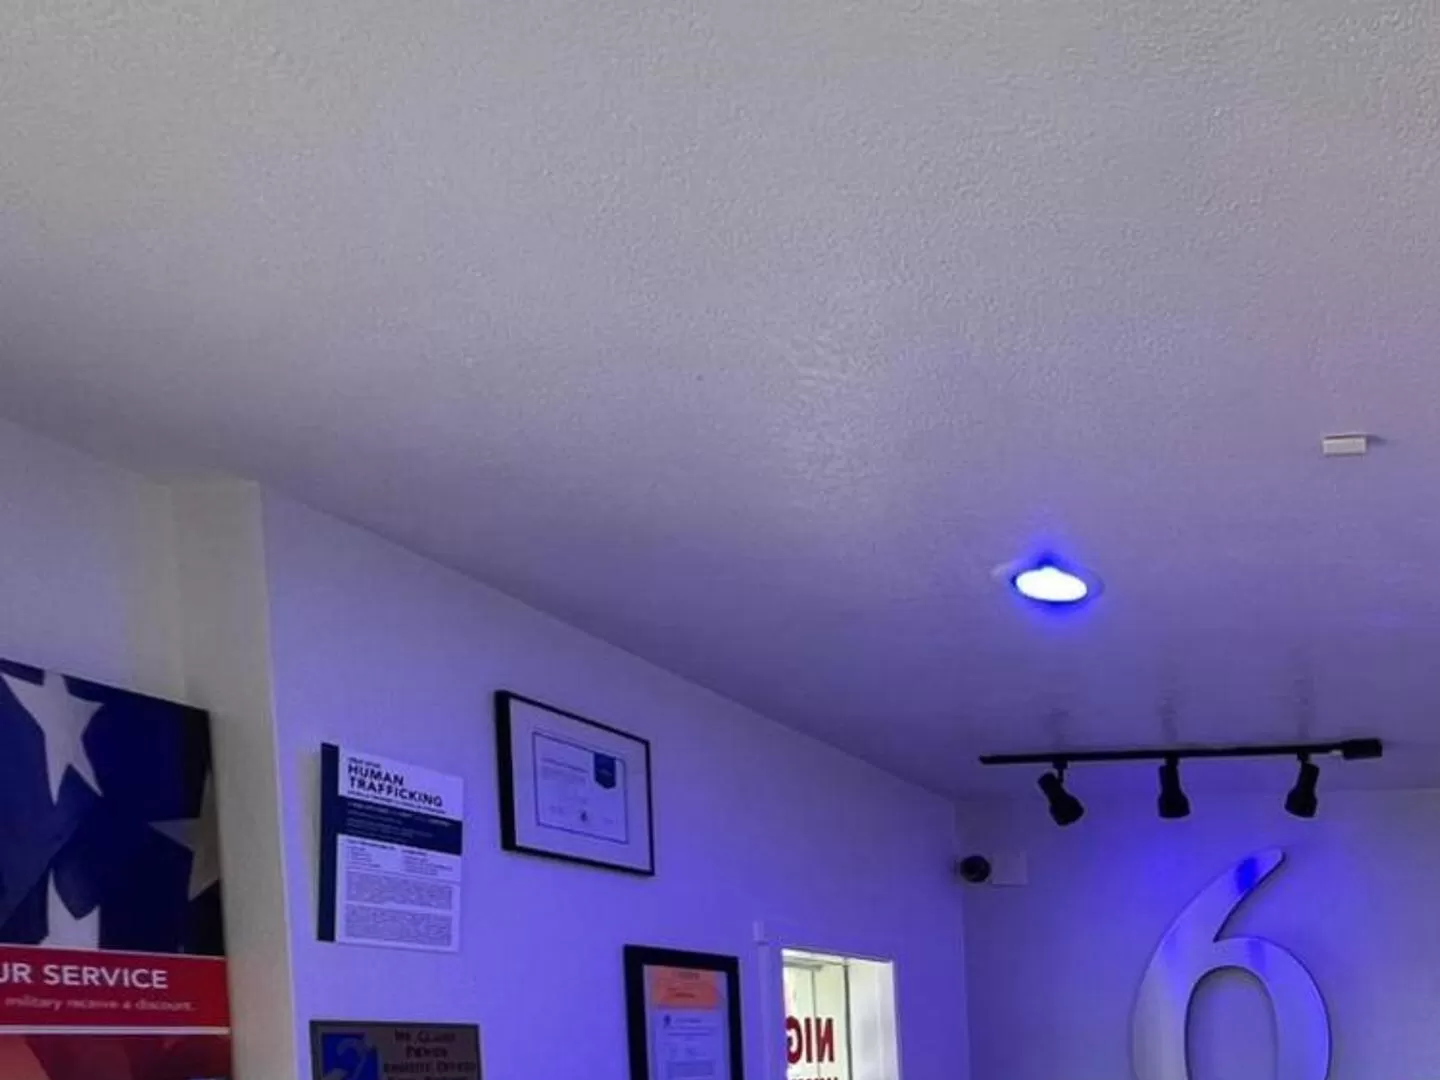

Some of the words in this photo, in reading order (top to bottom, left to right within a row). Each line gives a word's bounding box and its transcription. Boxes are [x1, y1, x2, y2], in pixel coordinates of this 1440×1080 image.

[348, 763, 404, 786] HUMAN
[350, 776, 443, 807] TRAFFICKING
[44, 964, 169, 989] SERVICE
